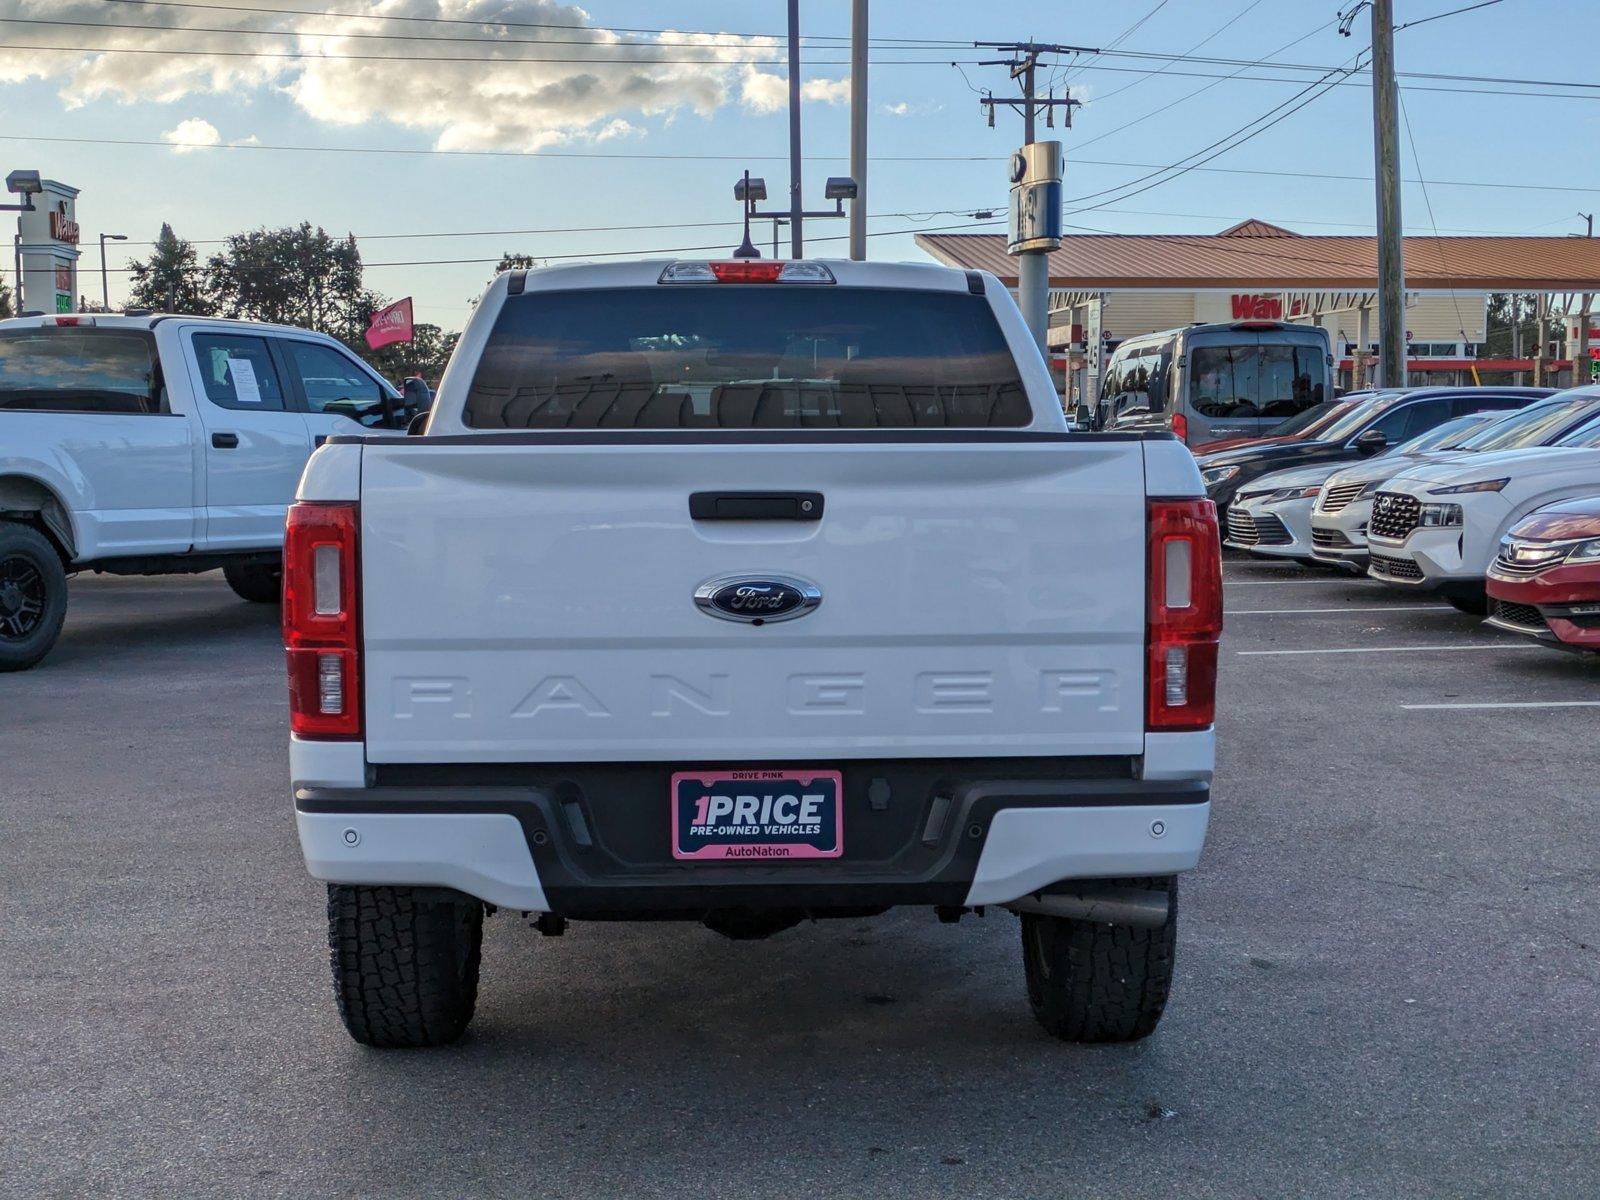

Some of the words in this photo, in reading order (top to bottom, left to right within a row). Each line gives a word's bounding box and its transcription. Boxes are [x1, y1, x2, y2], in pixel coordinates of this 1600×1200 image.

[1088, 345, 1098, 369] 45
[731, 586, 784, 608] Ford
[392, 669, 1119, 719] RANGER
[732, 772, 759, 780] DRIVE
[762, 771, 784, 779] PINK
[692, 795, 825, 825] 1PRICE
[690, 826, 760, 836] PRE-OWNED
[764, 824, 821, 835] VEHICLES
[725, 846, 790, 857] AutoNation
